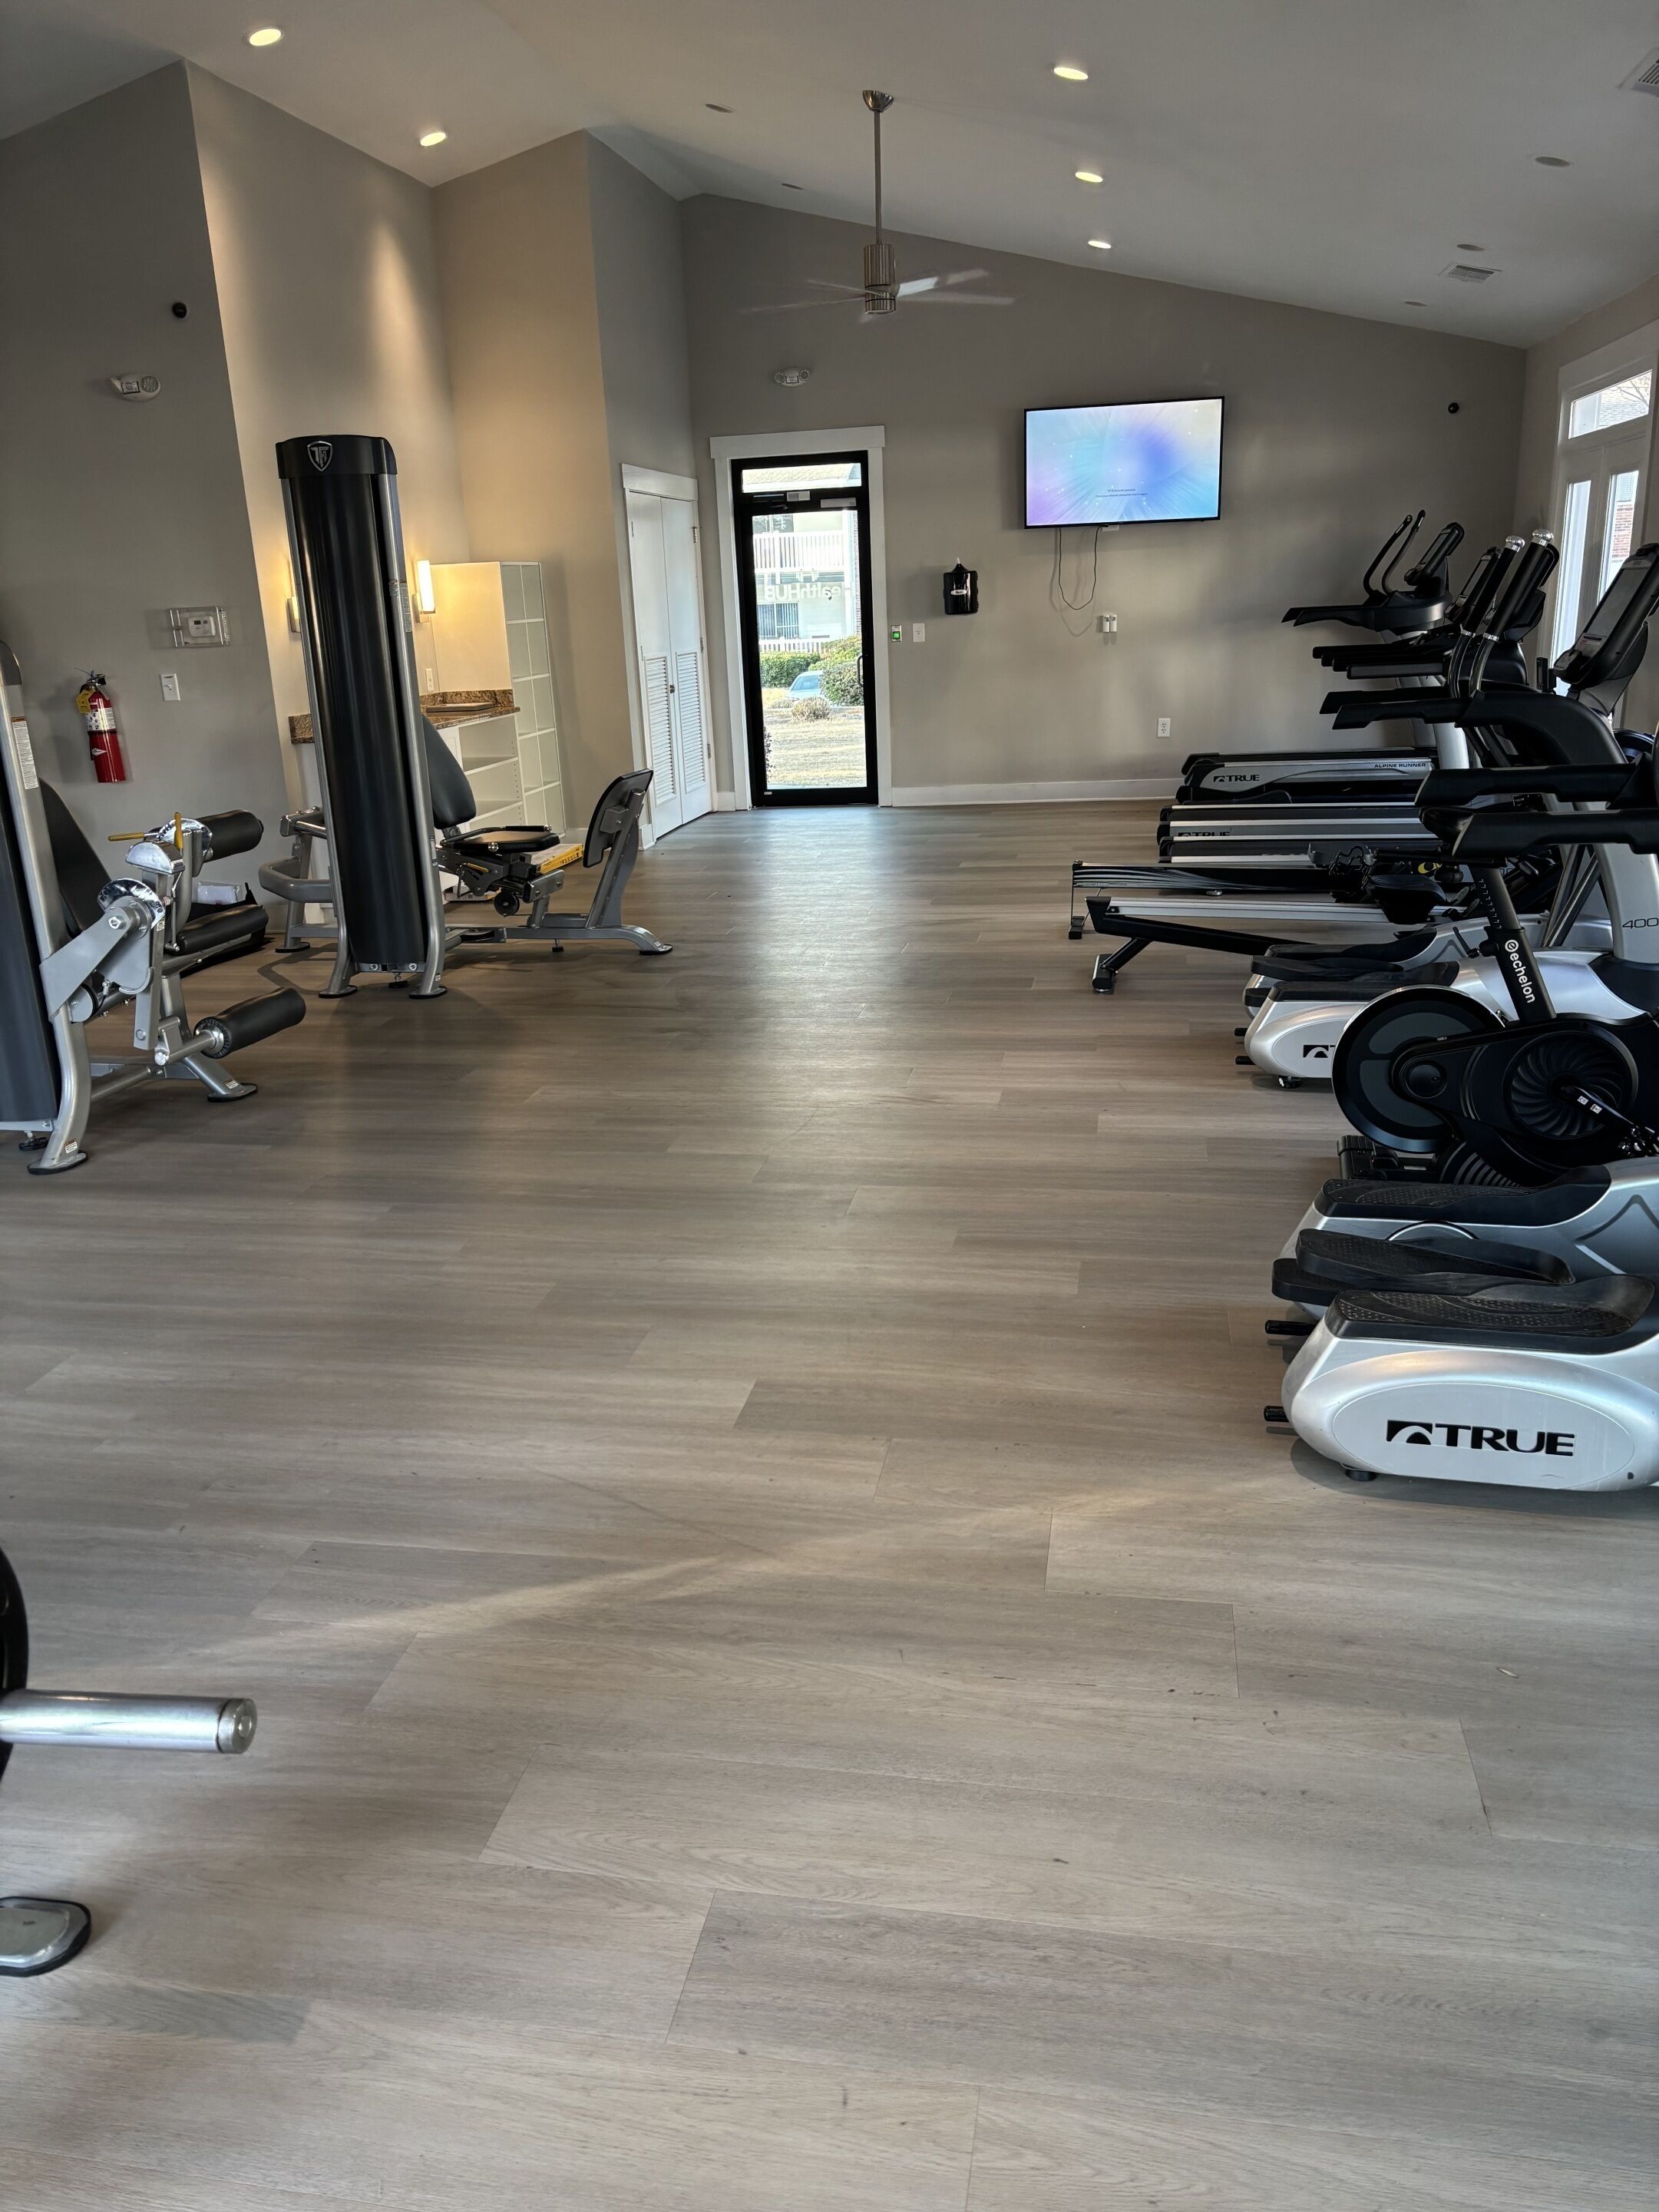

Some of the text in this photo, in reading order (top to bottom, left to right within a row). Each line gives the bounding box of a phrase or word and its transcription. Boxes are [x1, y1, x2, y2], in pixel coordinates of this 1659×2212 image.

[1225, 774, 1260, 782] TRUE
[1621, 917, 1659, 930] 400
[1509, 952, 1535, 1004] echelon
[1435, 1423, 1576, 1456] TRUE
